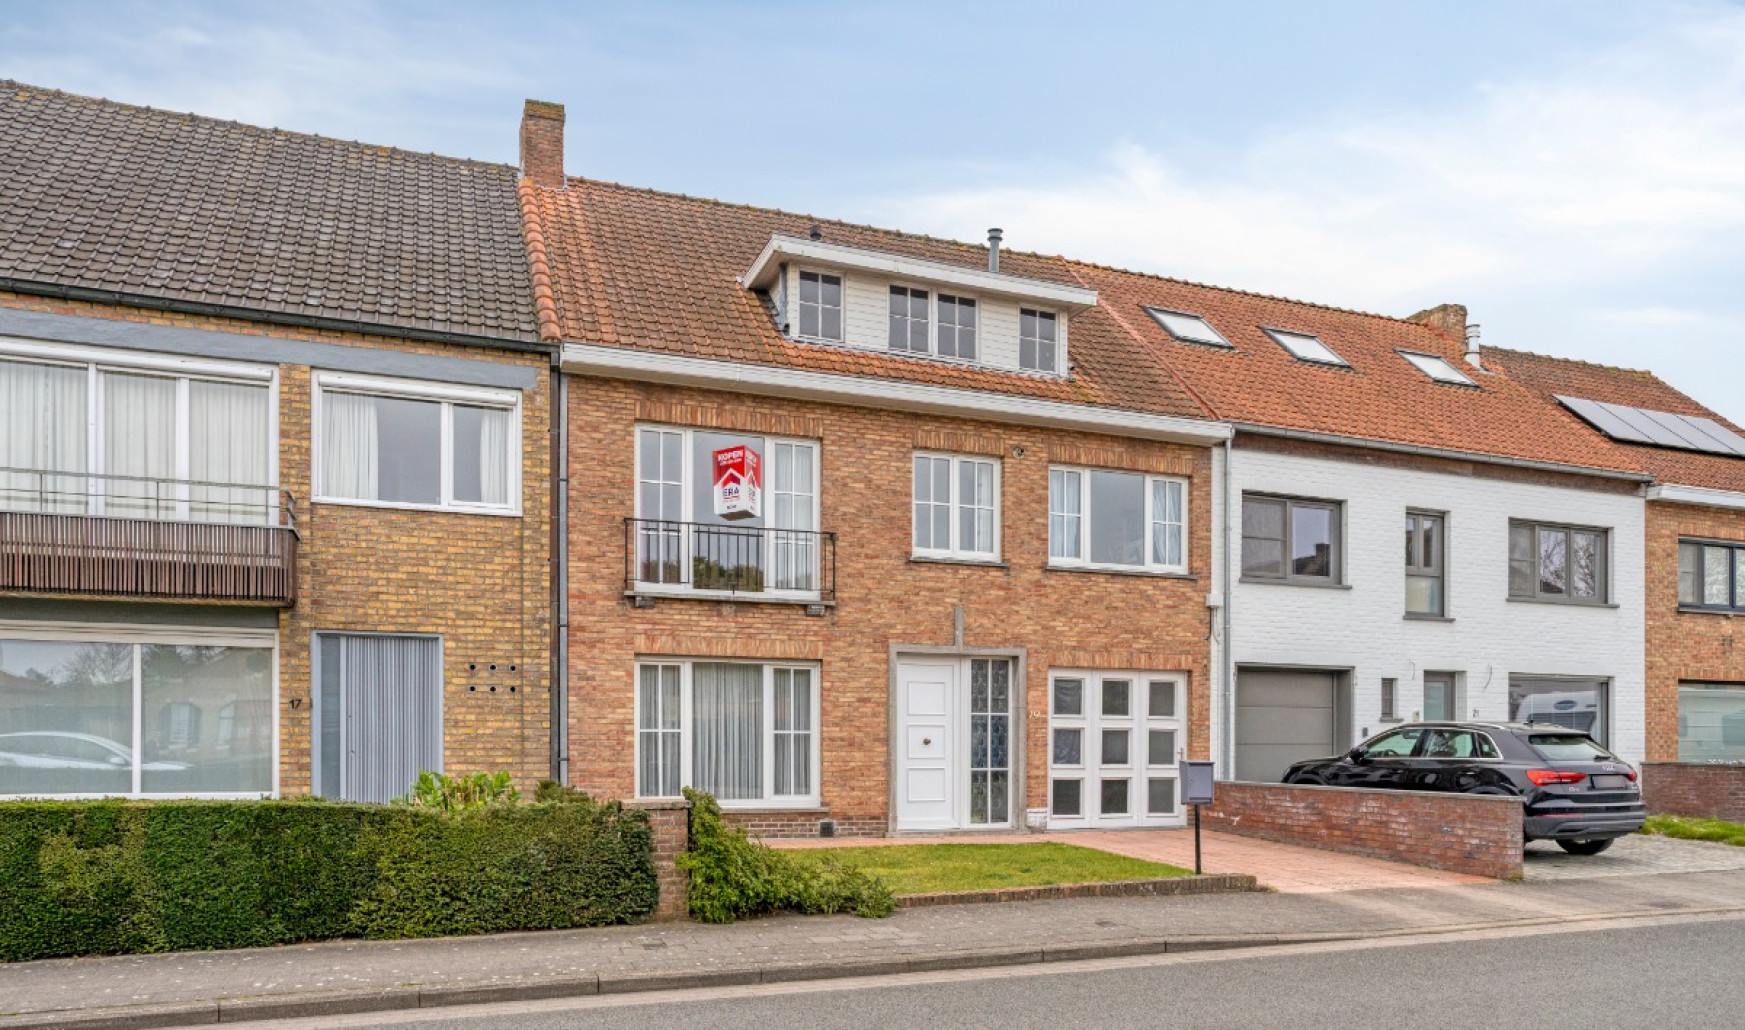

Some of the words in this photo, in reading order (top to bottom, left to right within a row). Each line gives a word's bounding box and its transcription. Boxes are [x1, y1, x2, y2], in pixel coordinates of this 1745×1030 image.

[718, 450, 744, 462] KOPEN
[723, 487, 739, 496] ERA
[289, 699, 301, 709] 17
